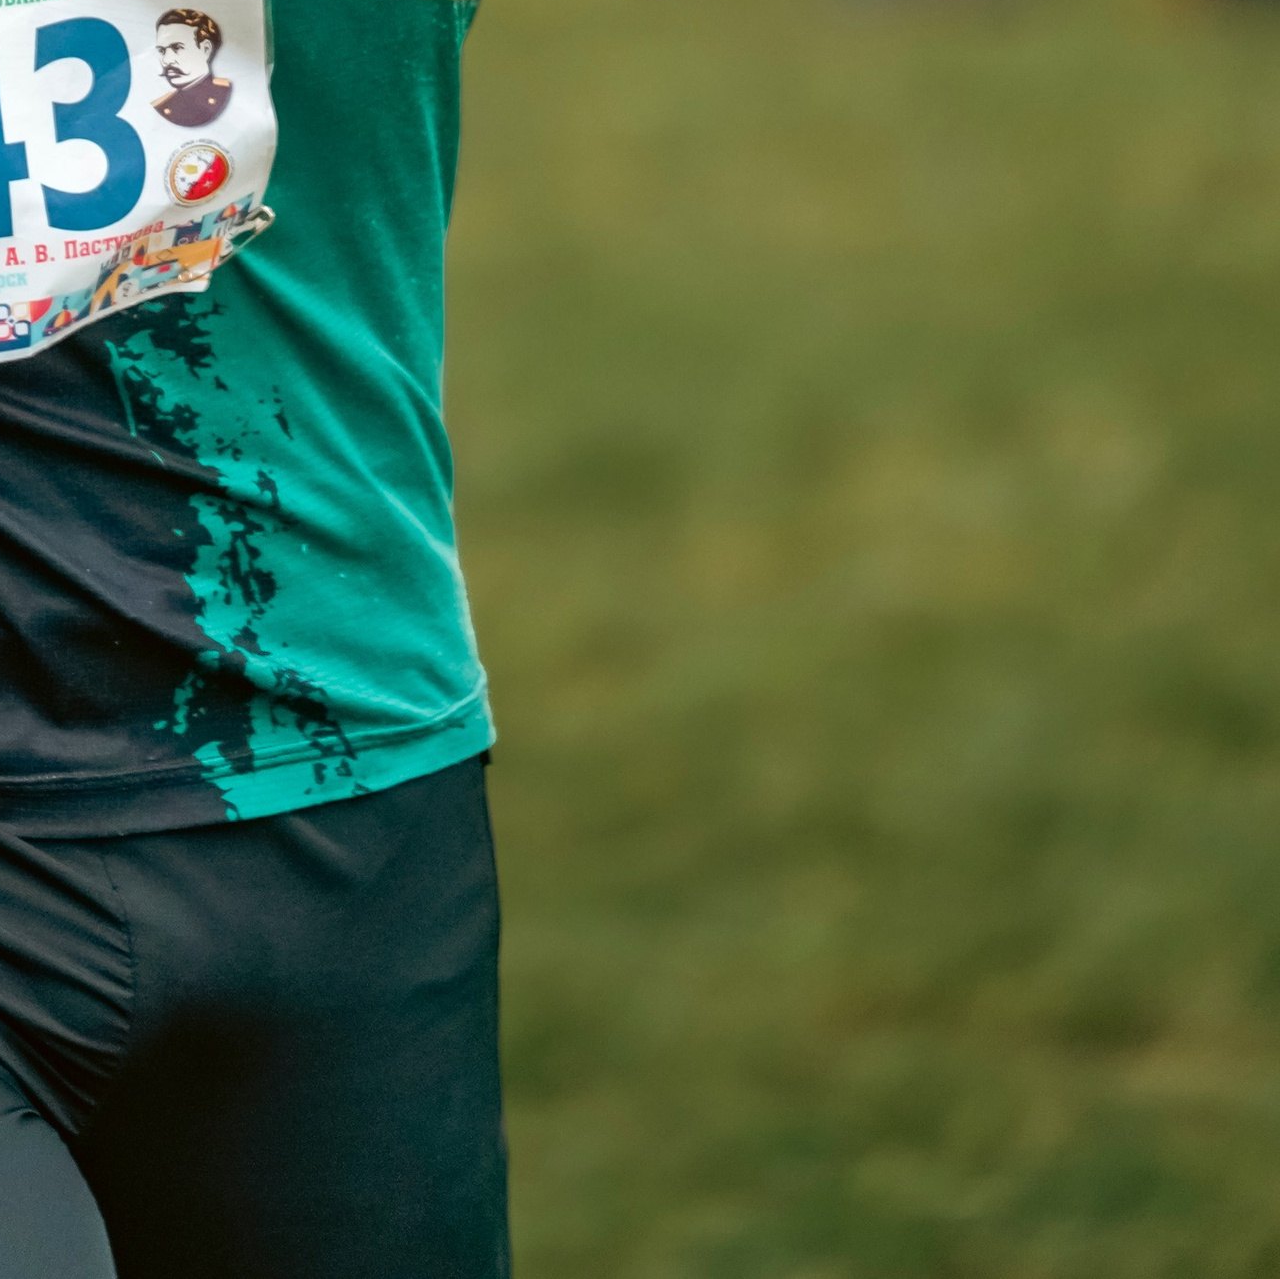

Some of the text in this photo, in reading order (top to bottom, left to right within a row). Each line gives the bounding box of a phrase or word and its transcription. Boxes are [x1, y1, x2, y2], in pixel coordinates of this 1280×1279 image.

[4, 246, 26, 267] А.
[34, 244, 56, 264] В.
[64, 220, 165, 260] Пастухова
